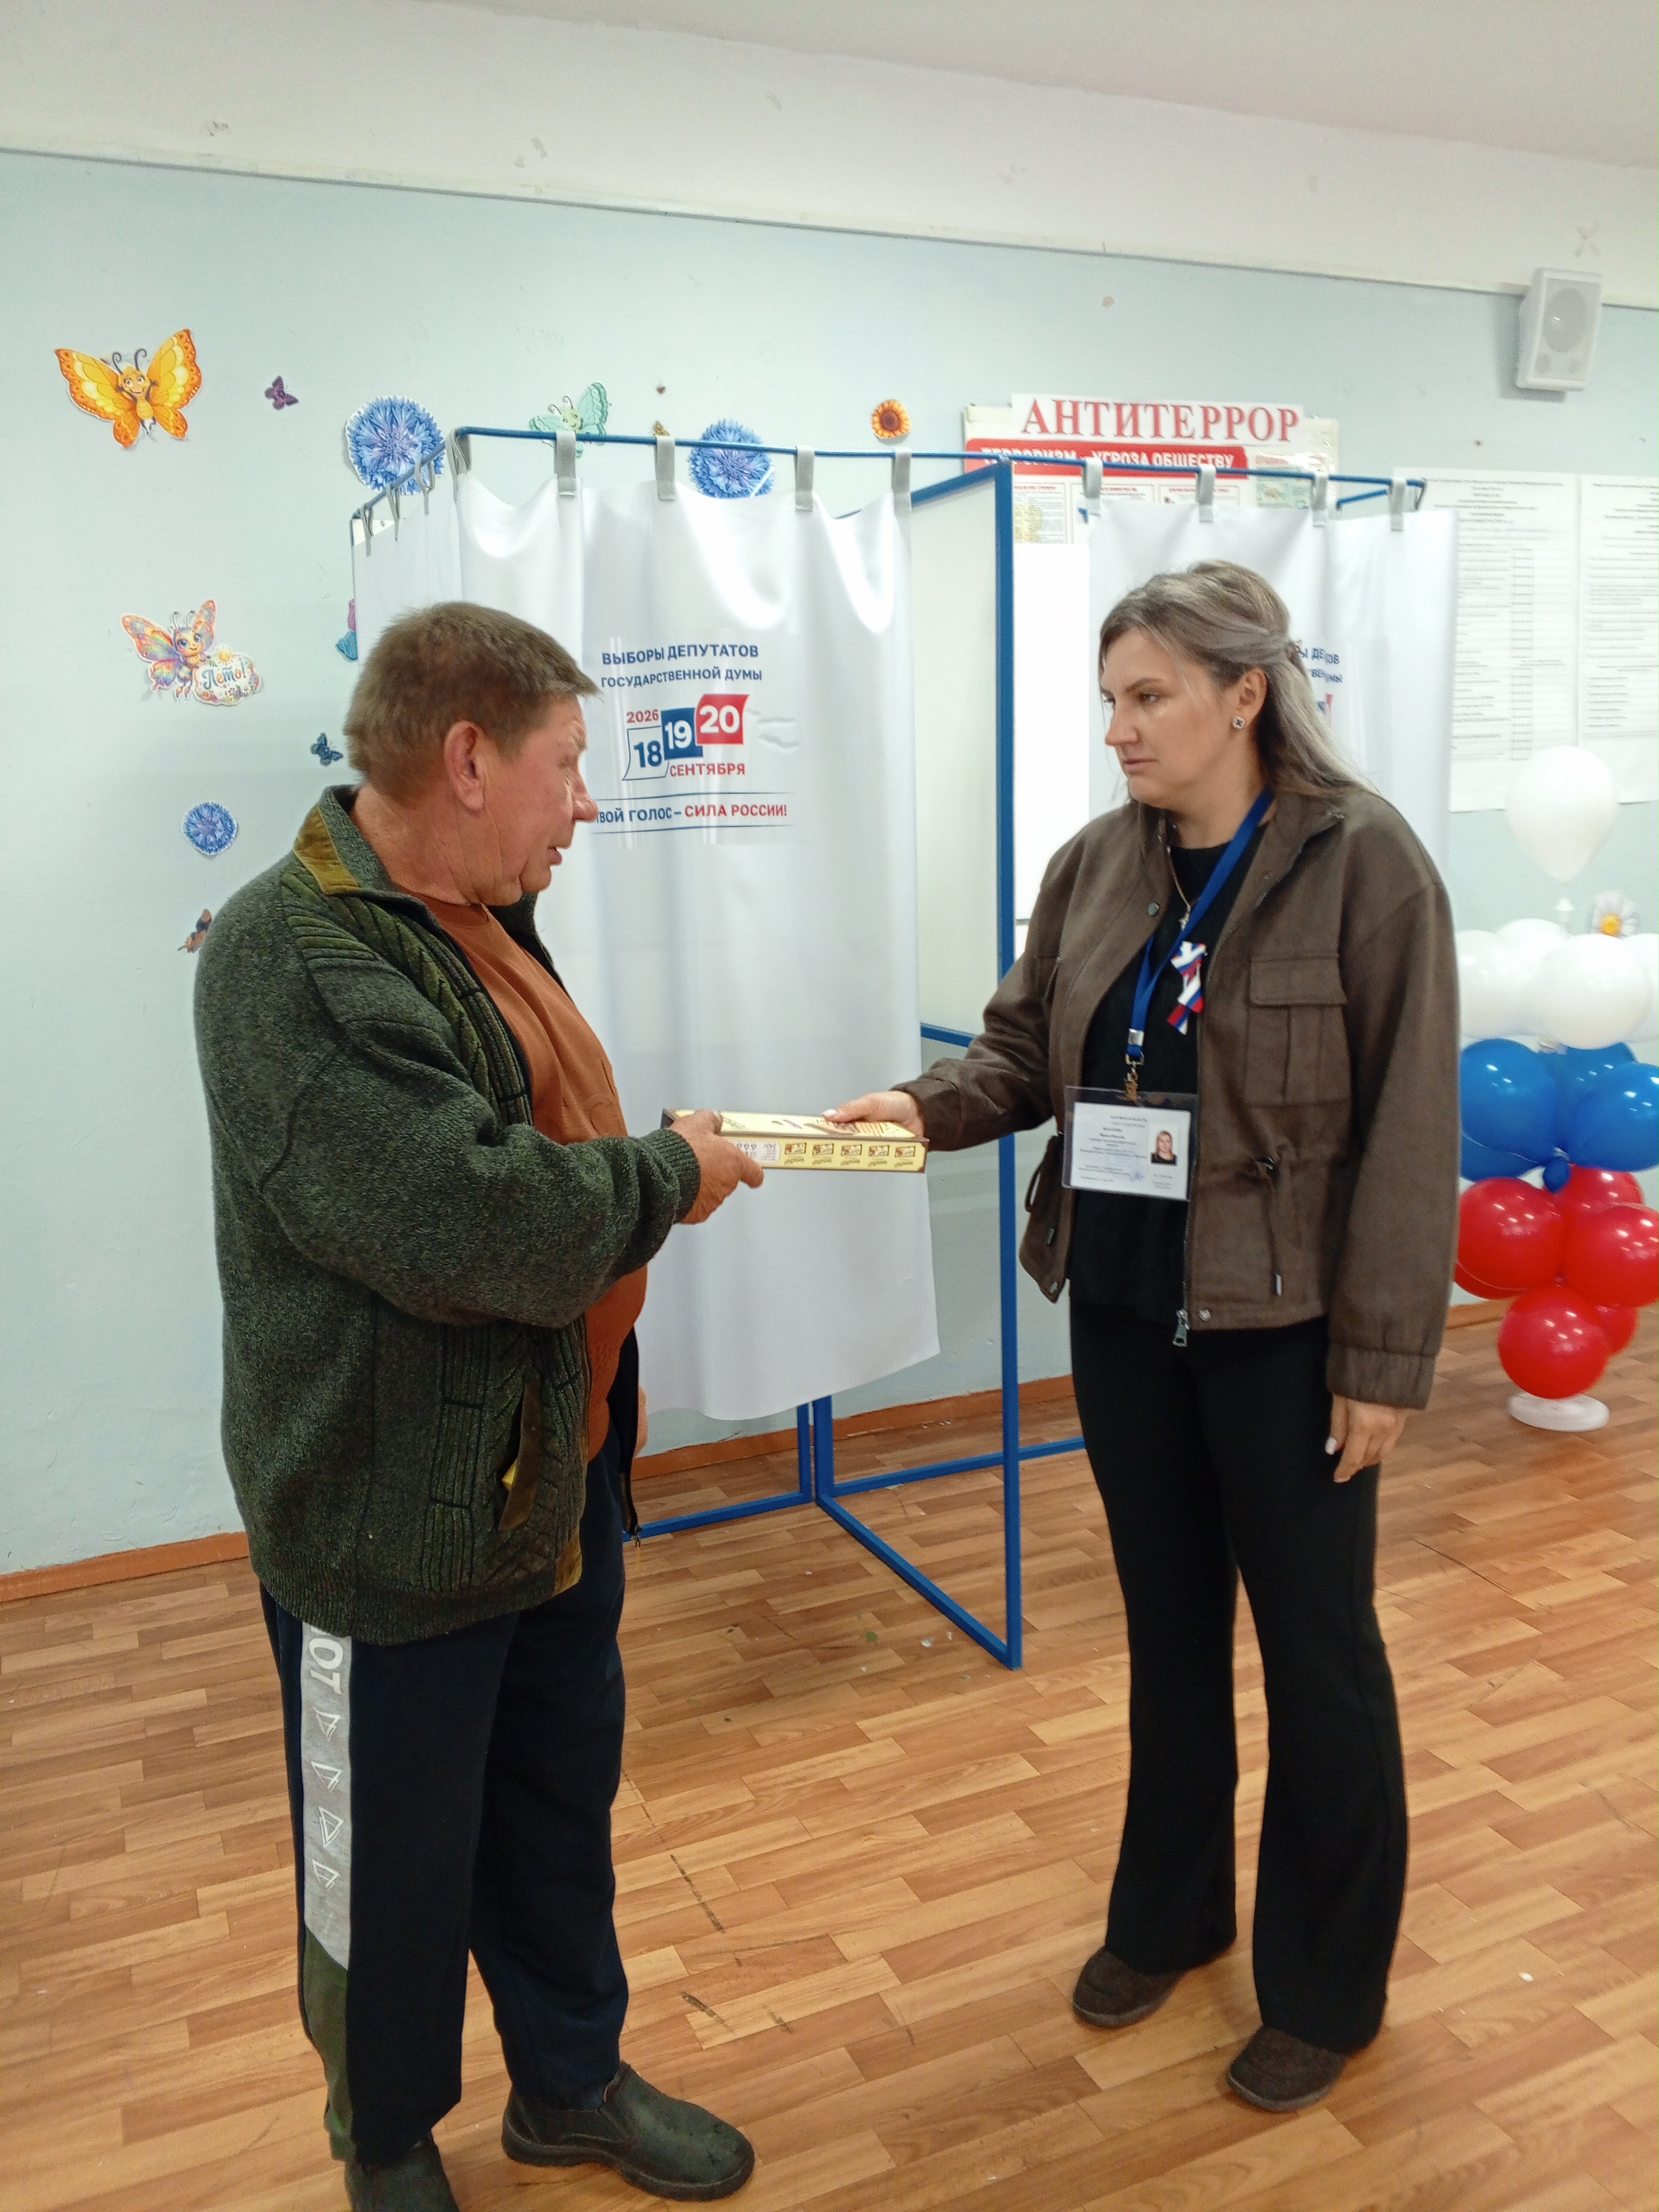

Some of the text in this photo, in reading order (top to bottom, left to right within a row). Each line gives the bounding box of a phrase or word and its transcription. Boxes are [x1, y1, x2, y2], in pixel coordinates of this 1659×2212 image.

[1021, 398, 1300, 442] АНТИТЕРРОР
[1152, 452, 1234, 468] ОБЩЕСТВУ
[602, 644, 759, 665] ВЫБОРЫ ДЕПУТАТОВ
[202, 661, 245, 690] Лето!
[601, 666, 763, 688] ГОСУДАРСТВЕННОЙ ДУМЫ
[626, 710, 659, 723] 2026
[634, 705, 740, 768] 18 19 20
[669, 763, 746, 777] СЕНТЯБРЯ
[629, 807, 672, 822] ГОЛОС
[685, 804, 727, 817] СИЛА
[732, 804, 788, 816] РОССИИ!
[308, 1626, 344, 1695] OT
